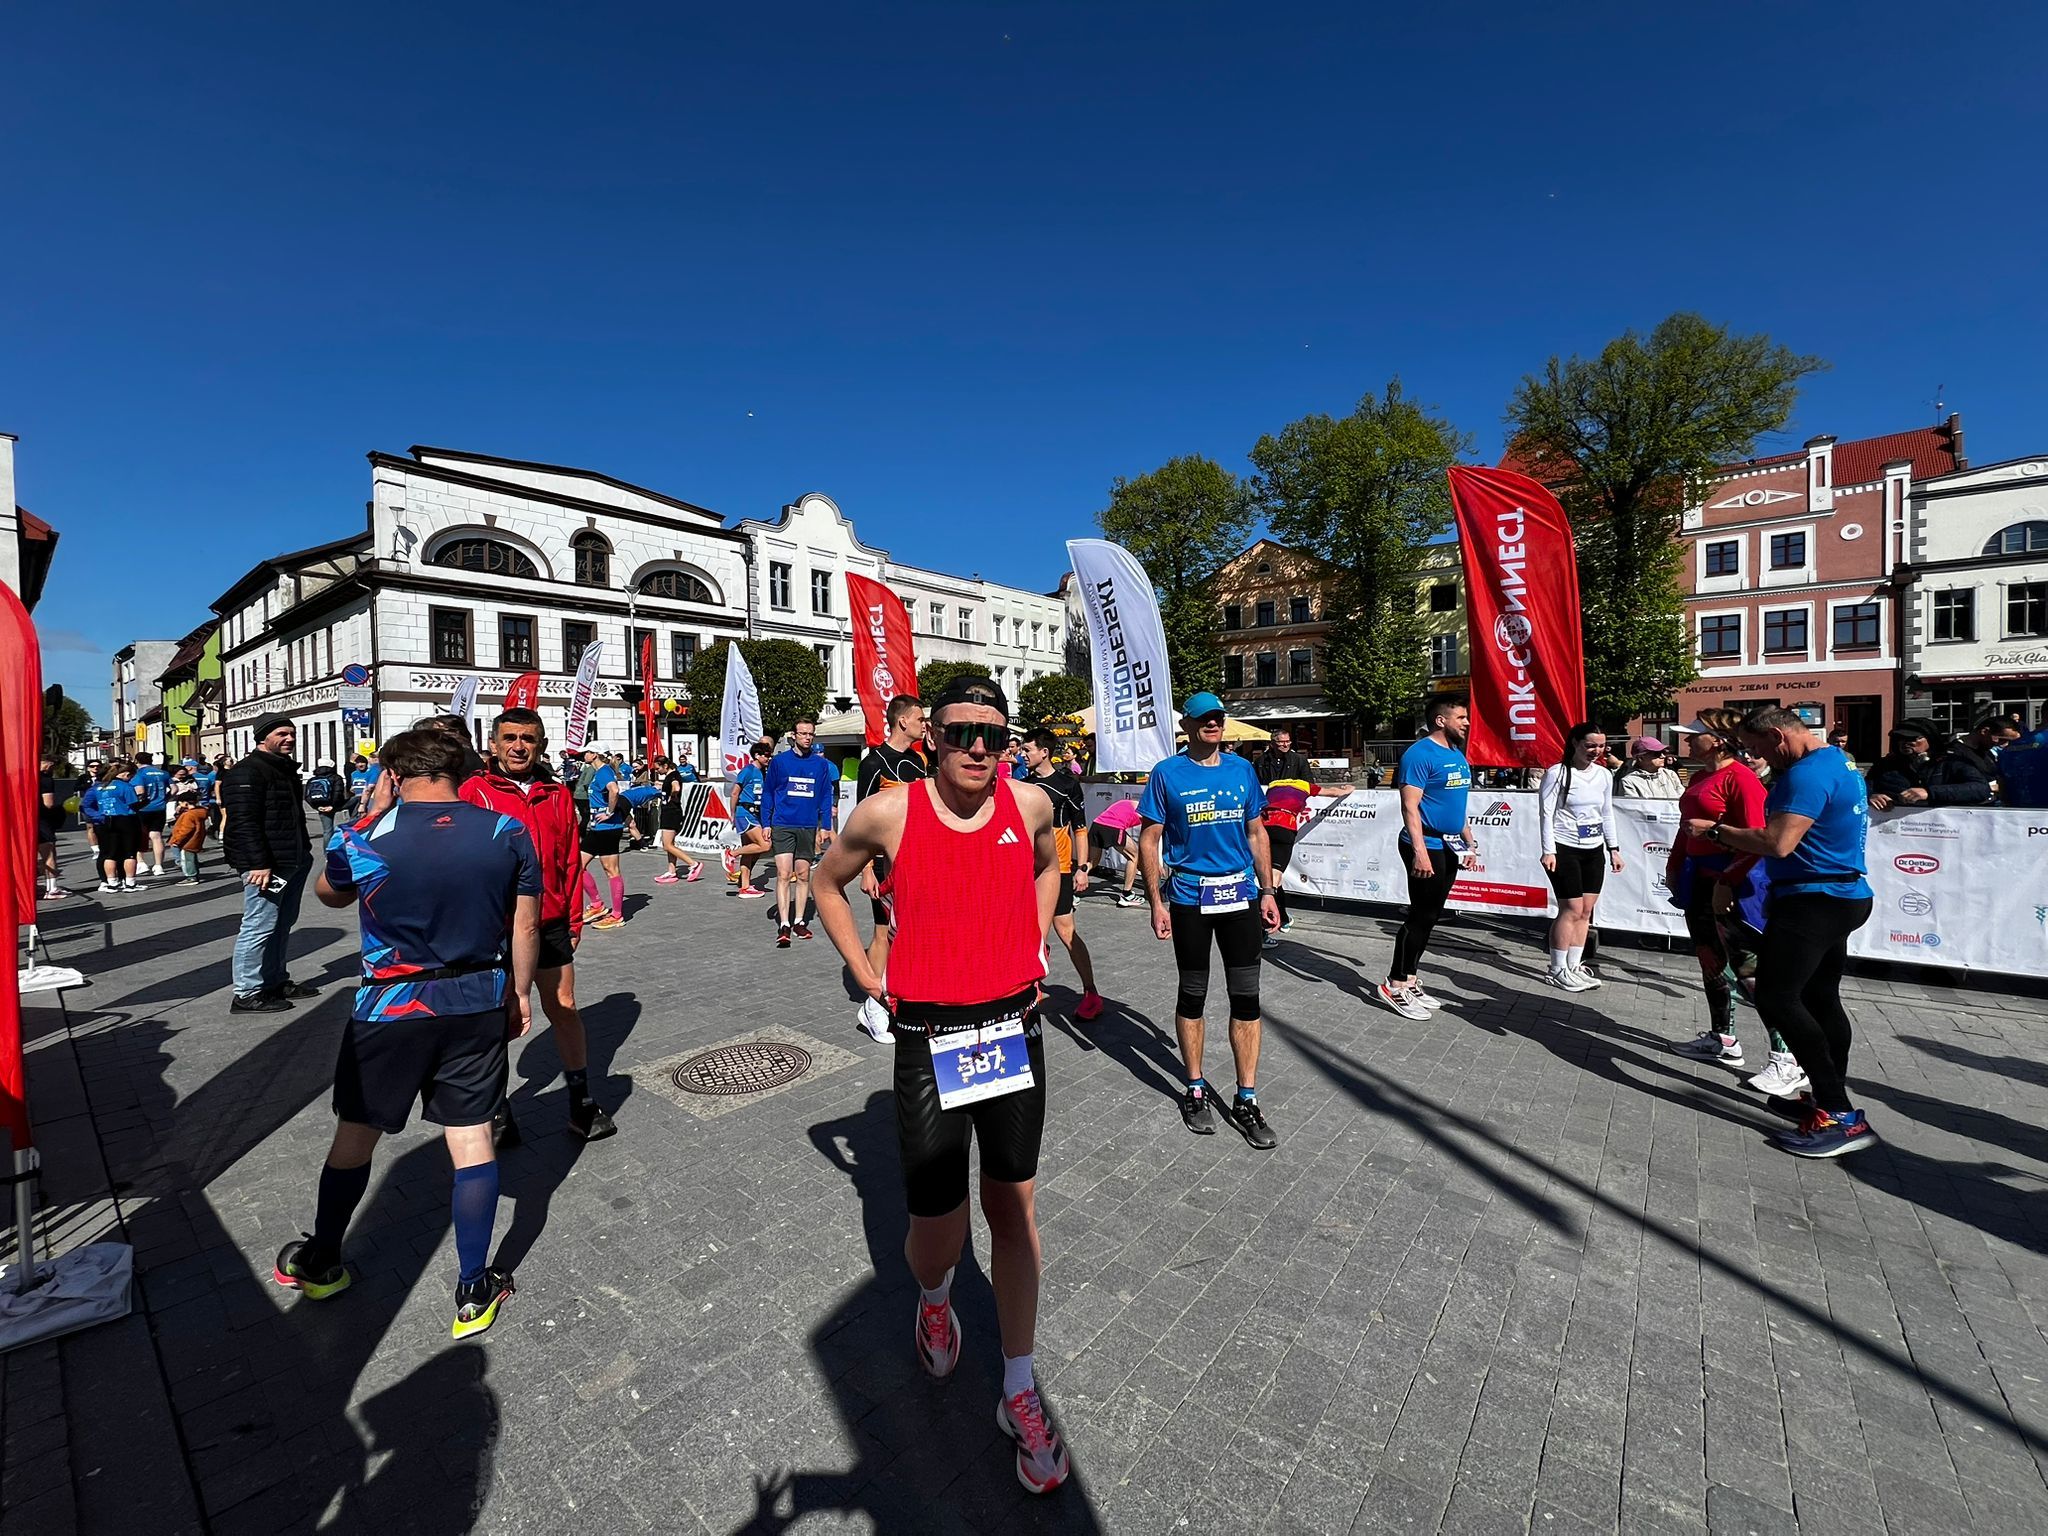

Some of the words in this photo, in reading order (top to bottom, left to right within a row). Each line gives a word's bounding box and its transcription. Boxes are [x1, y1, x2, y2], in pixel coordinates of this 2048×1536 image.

[1984, 653, 2024, 668] Puck
[1685, 684, 1732, 694] MUZEUM
[1739, 683, 1769, 692] ZIEMI
[1776, 681, 1821, 690] PUCKIEJ
[567, 682, 592, 748] CZANIECKI
[1185, 800, 1216, 814] BIEG
[1314, 808, 1377, 819] TRIATHLON
